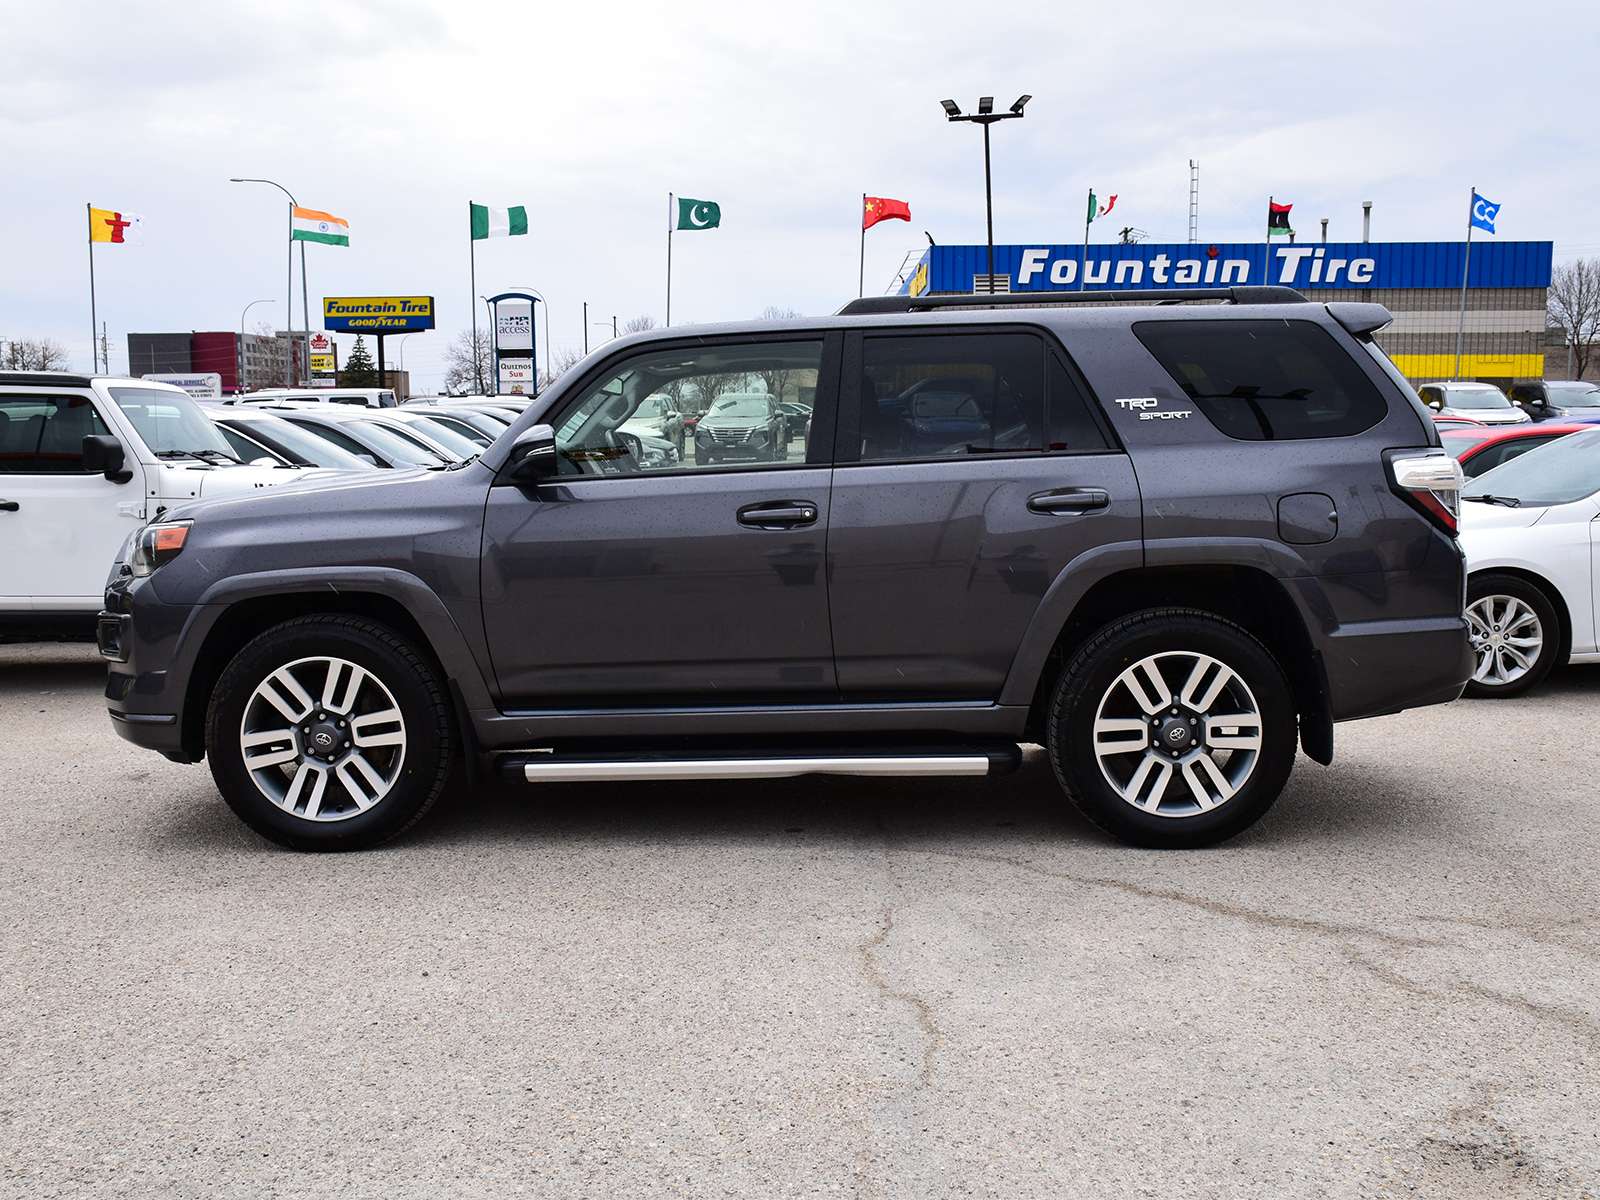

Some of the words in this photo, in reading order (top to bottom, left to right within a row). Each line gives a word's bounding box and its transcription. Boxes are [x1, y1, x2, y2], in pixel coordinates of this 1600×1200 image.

[1017, 246, 1251, 285] Fountain
[1275, 247, 1376, 284] Tire
[326, 300, 397, 314] Fountain
[400, 300, 429, 313] Tire
[348, 318, 408, 328] GOODYEAR
[499, 326, 530, 334] access
[1115, 398, 1158, 411] TRD
[1140, 411, 1192, 420] SPORT
